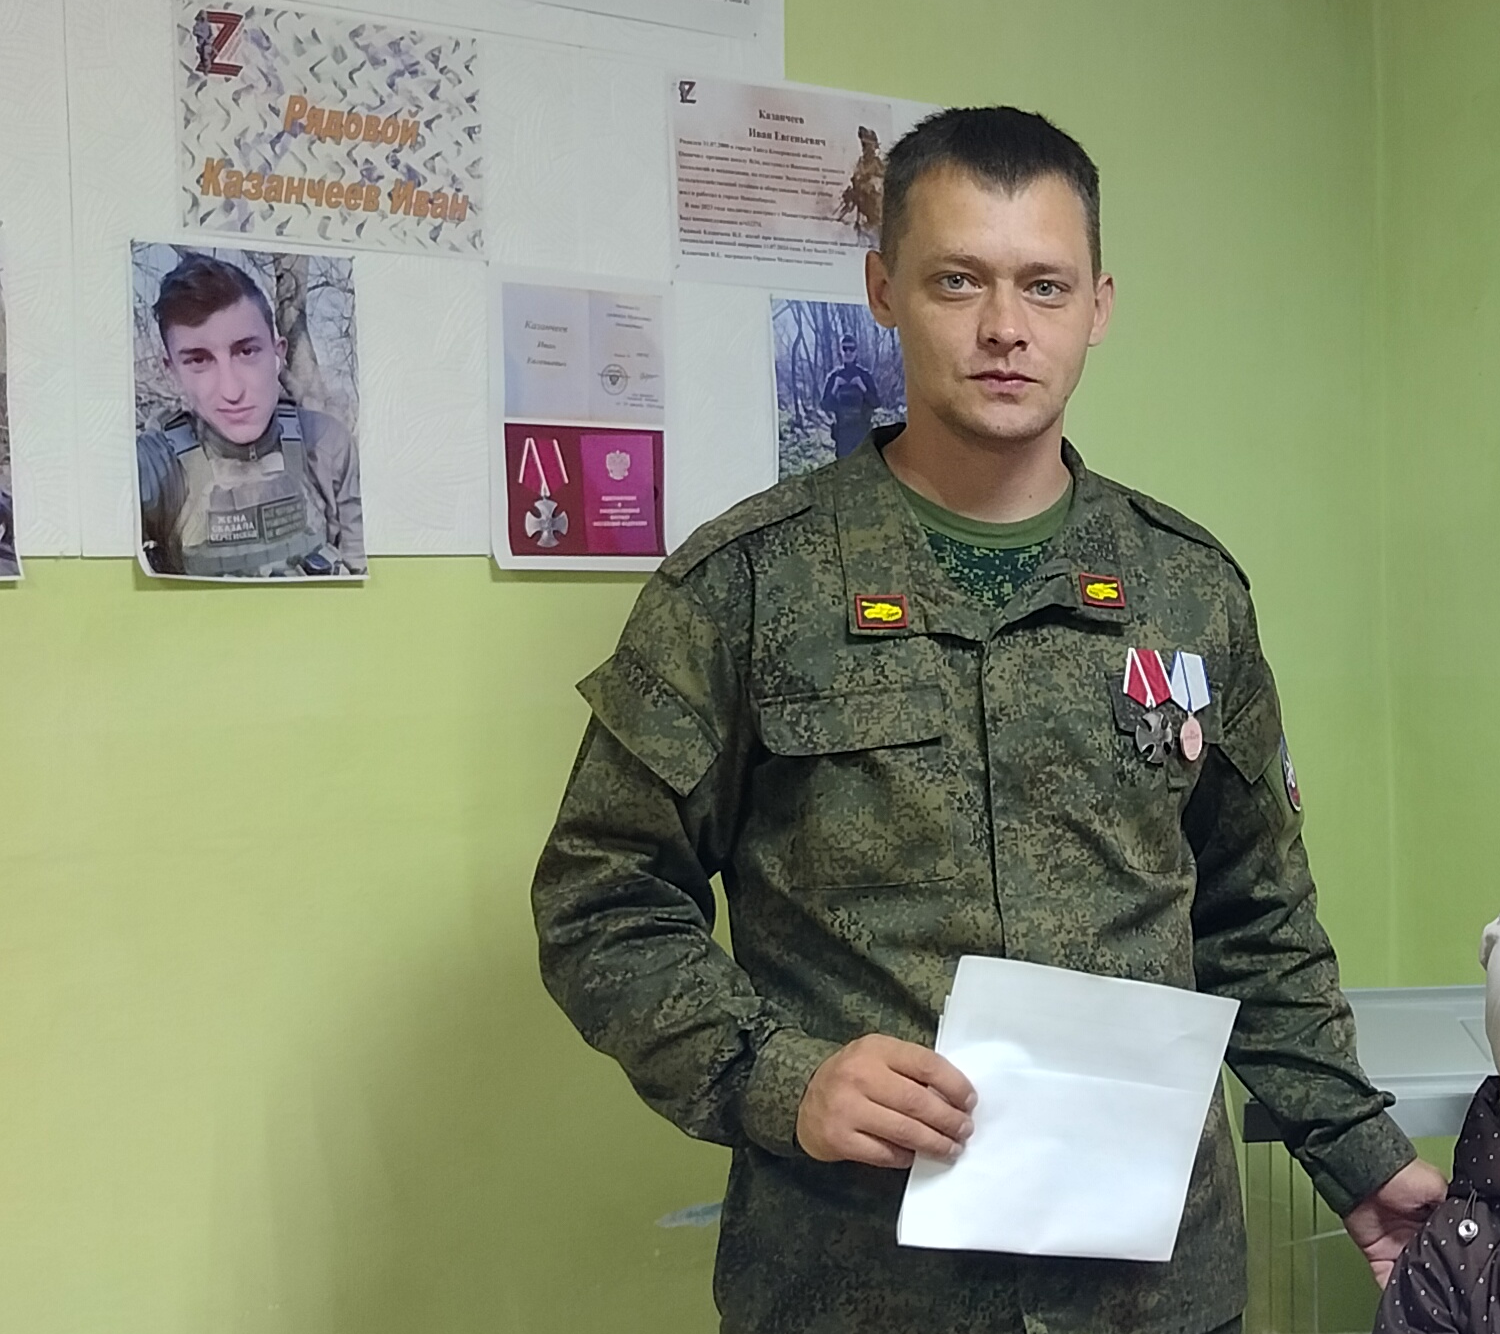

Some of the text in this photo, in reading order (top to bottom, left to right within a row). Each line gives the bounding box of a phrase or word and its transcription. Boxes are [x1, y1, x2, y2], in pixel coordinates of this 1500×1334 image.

[284, 95, 420, 145] Рядовой
[201, 157, 468, 221] Казанчеев Иван
